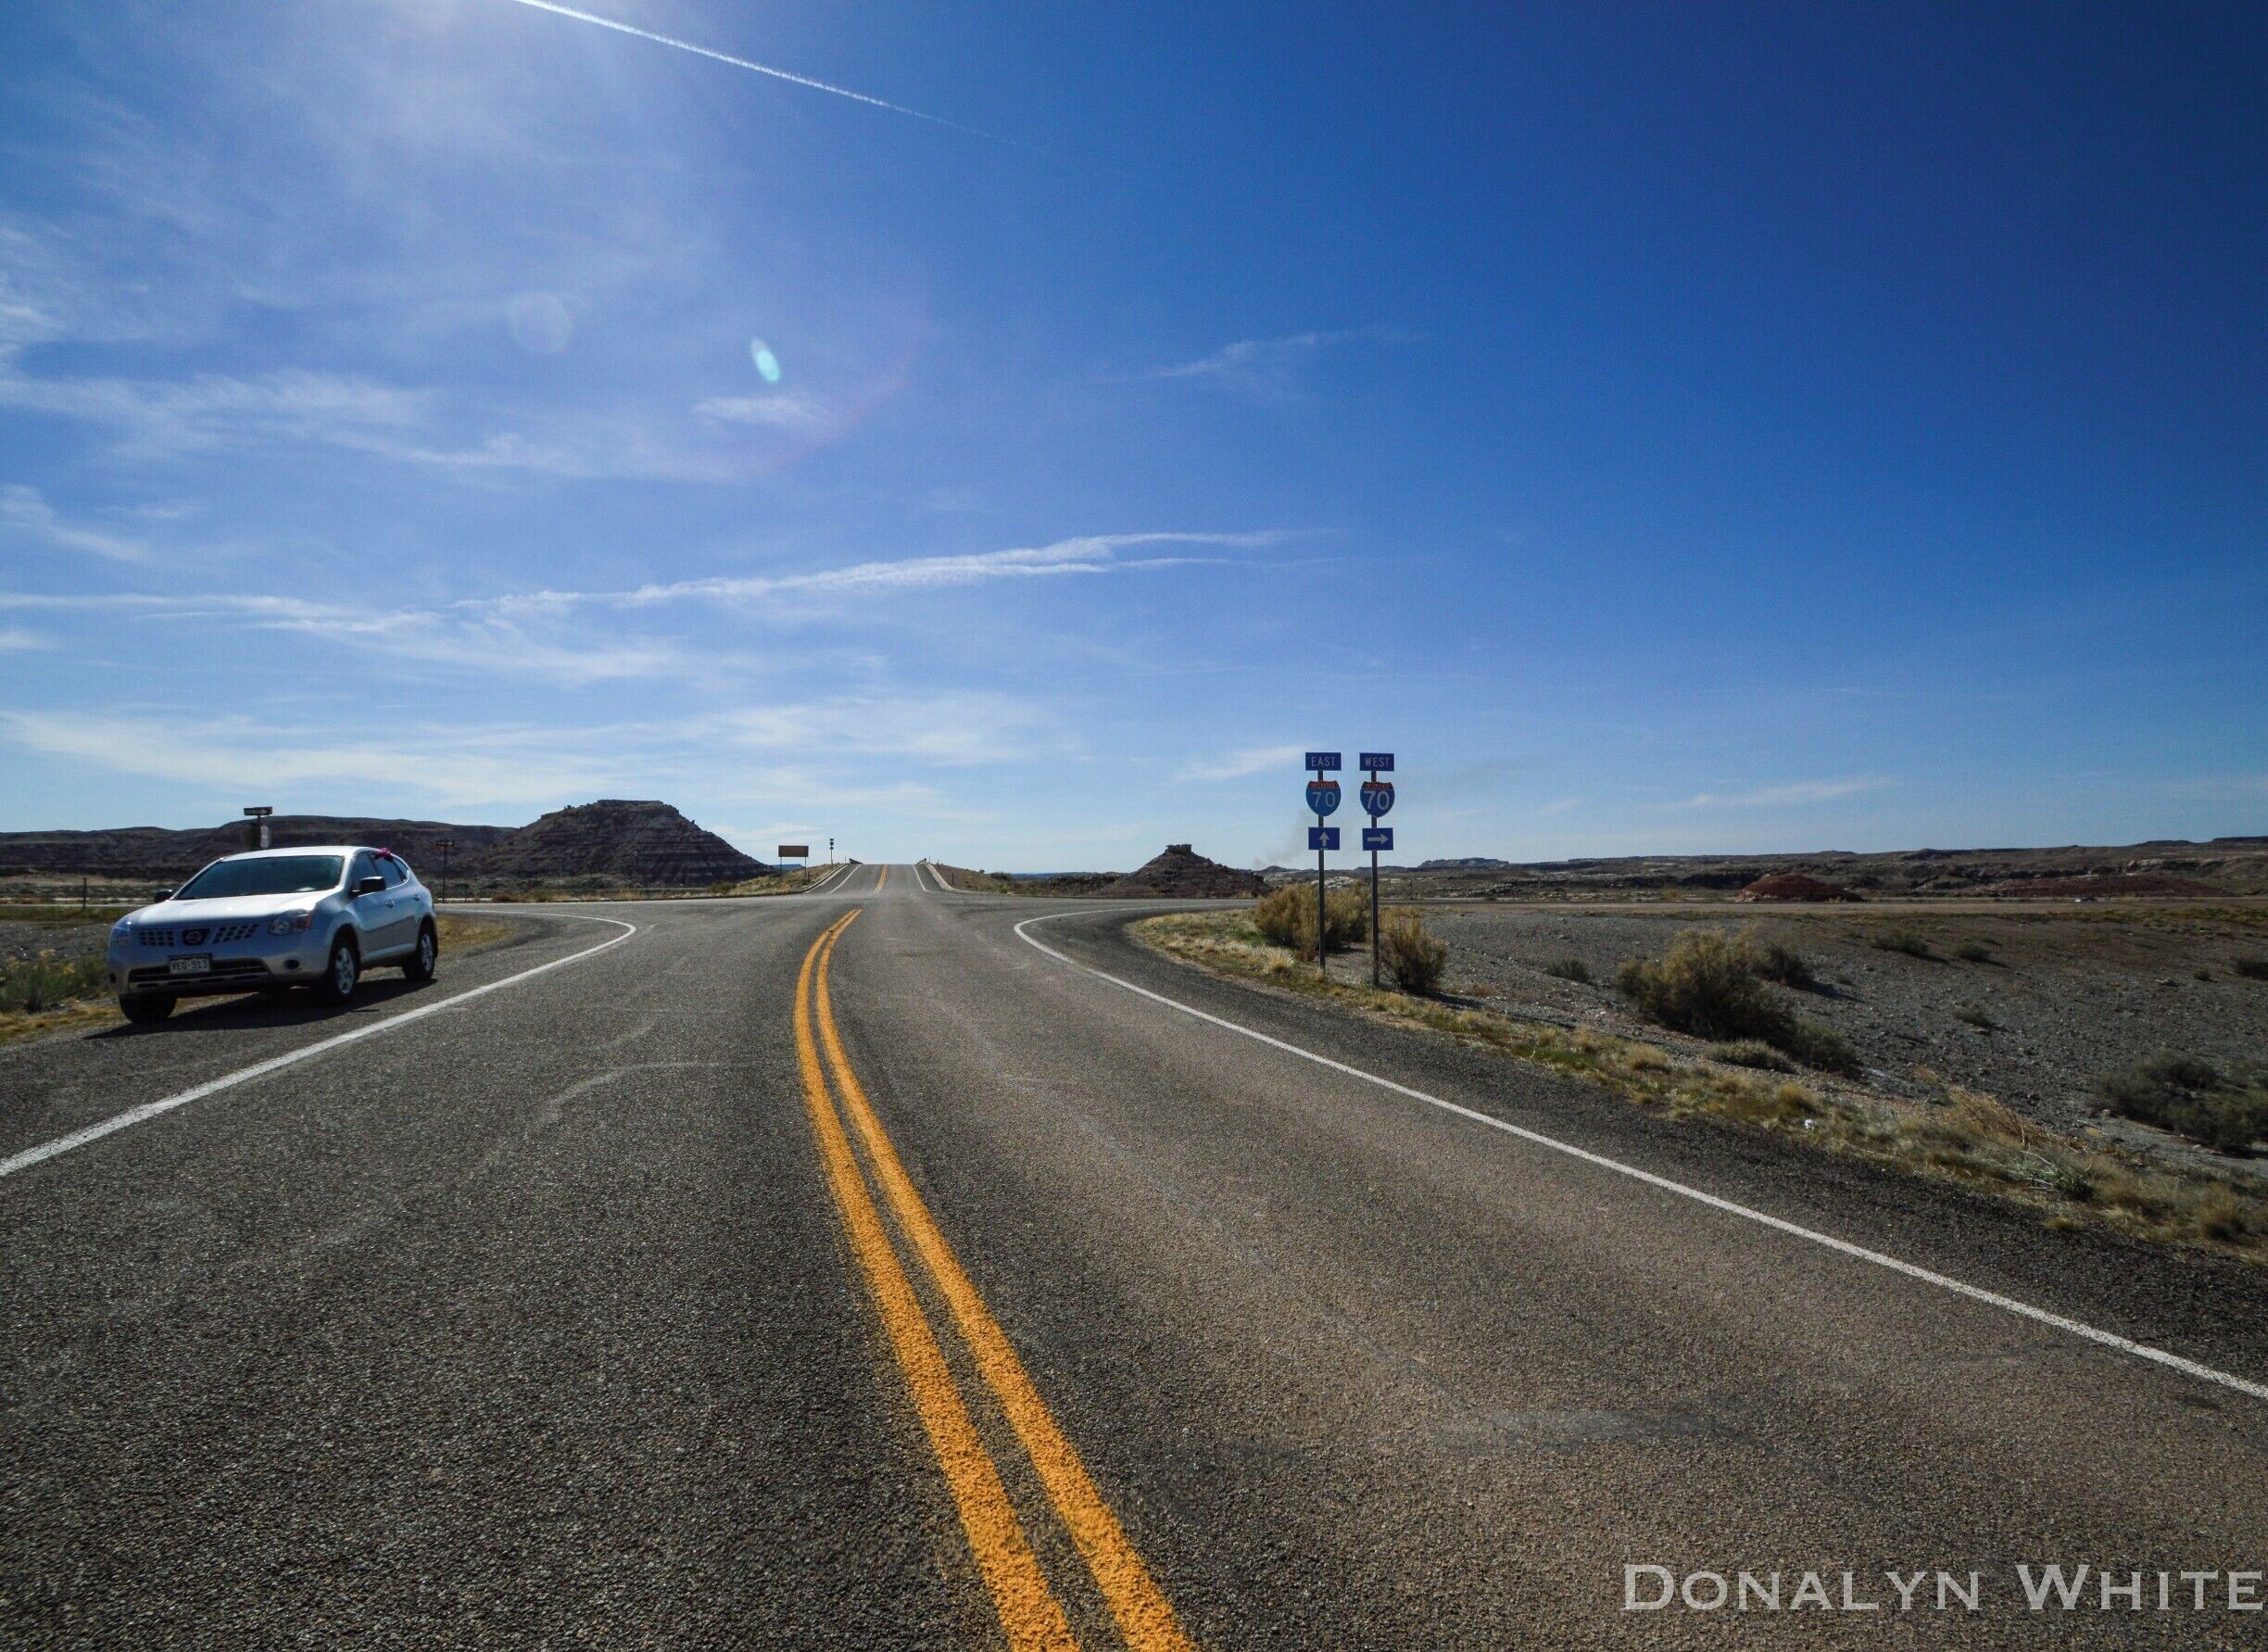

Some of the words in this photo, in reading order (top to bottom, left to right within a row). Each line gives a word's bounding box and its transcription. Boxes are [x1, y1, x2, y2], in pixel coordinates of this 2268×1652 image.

[1311, 756, 1336, 767] EAST
[1365, 756, 1390, 768] WEST
[1312, 791, 1335, 807] 70
[1364, 789, 1390, 811] 70
